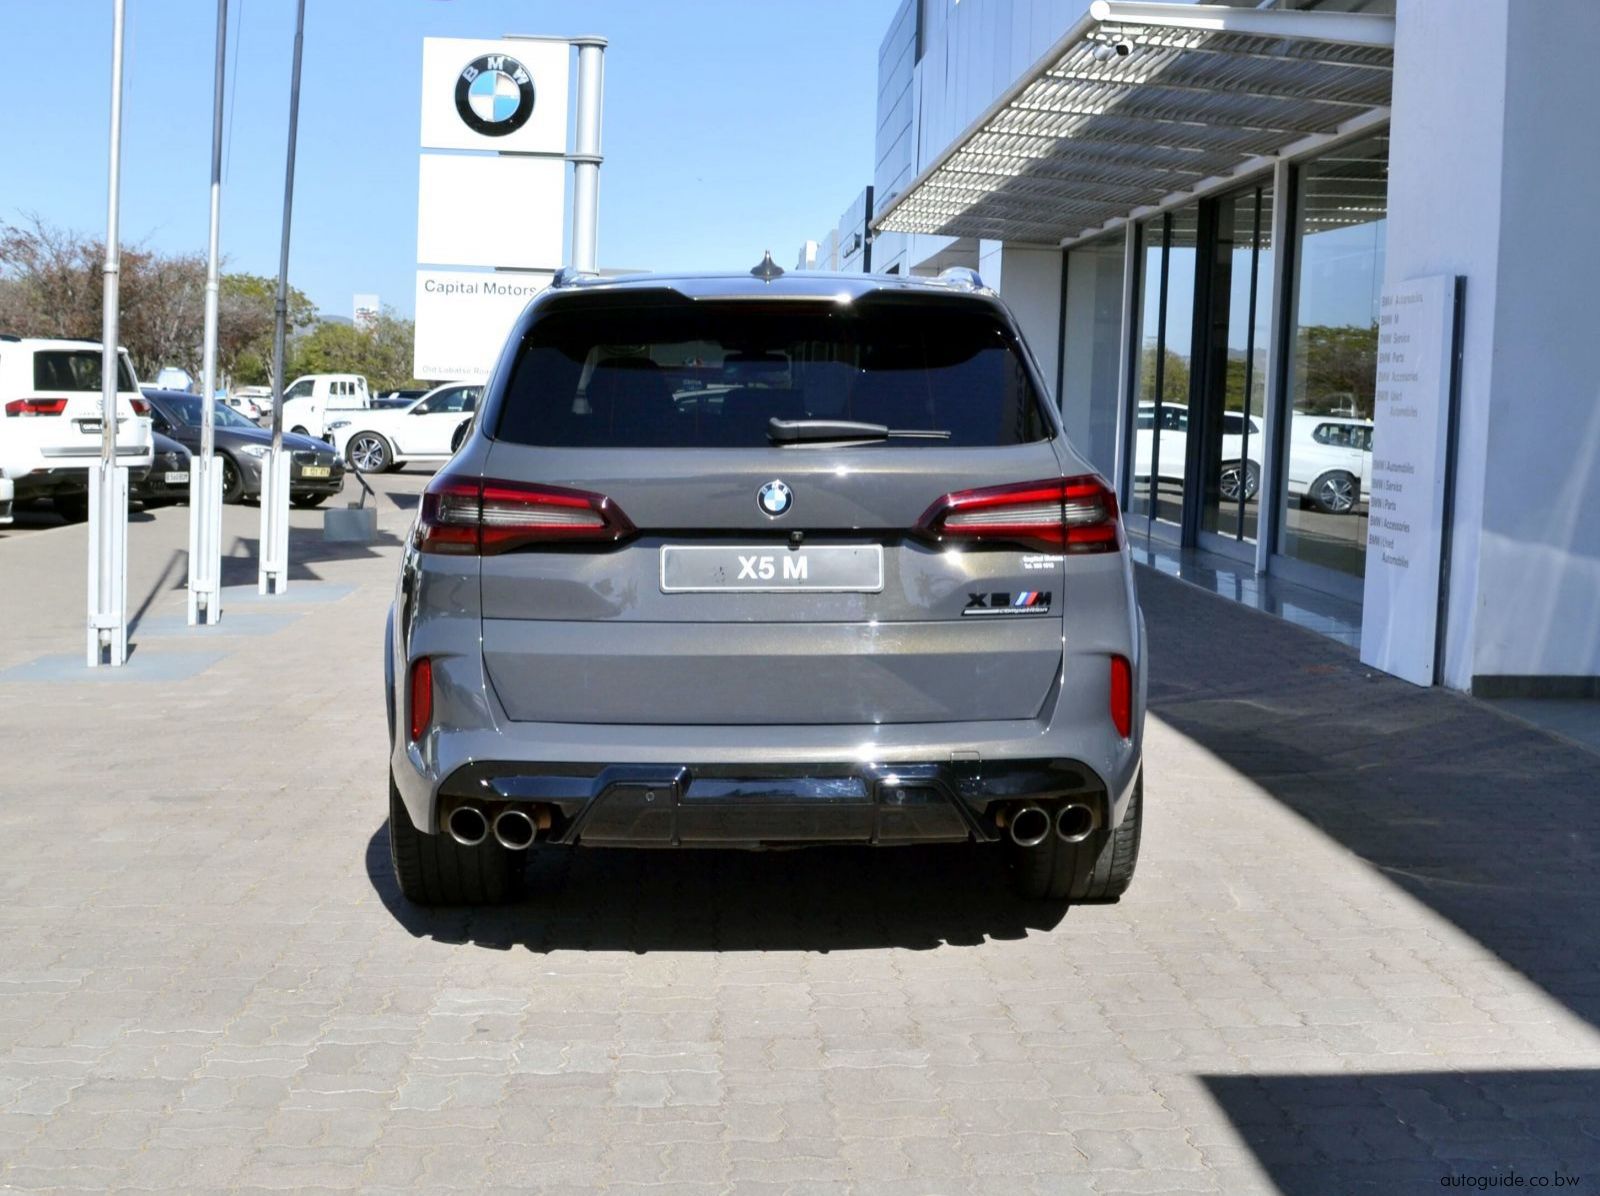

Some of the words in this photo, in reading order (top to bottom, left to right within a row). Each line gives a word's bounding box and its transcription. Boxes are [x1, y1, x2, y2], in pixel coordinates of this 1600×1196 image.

[462, 56, 530, 85] BMW
[425, 279, 479, 295] Capital
[484, 282, 537, 296] Motors
[737, 556, 775, 579] X5
[783, 556, 808, 579] M
